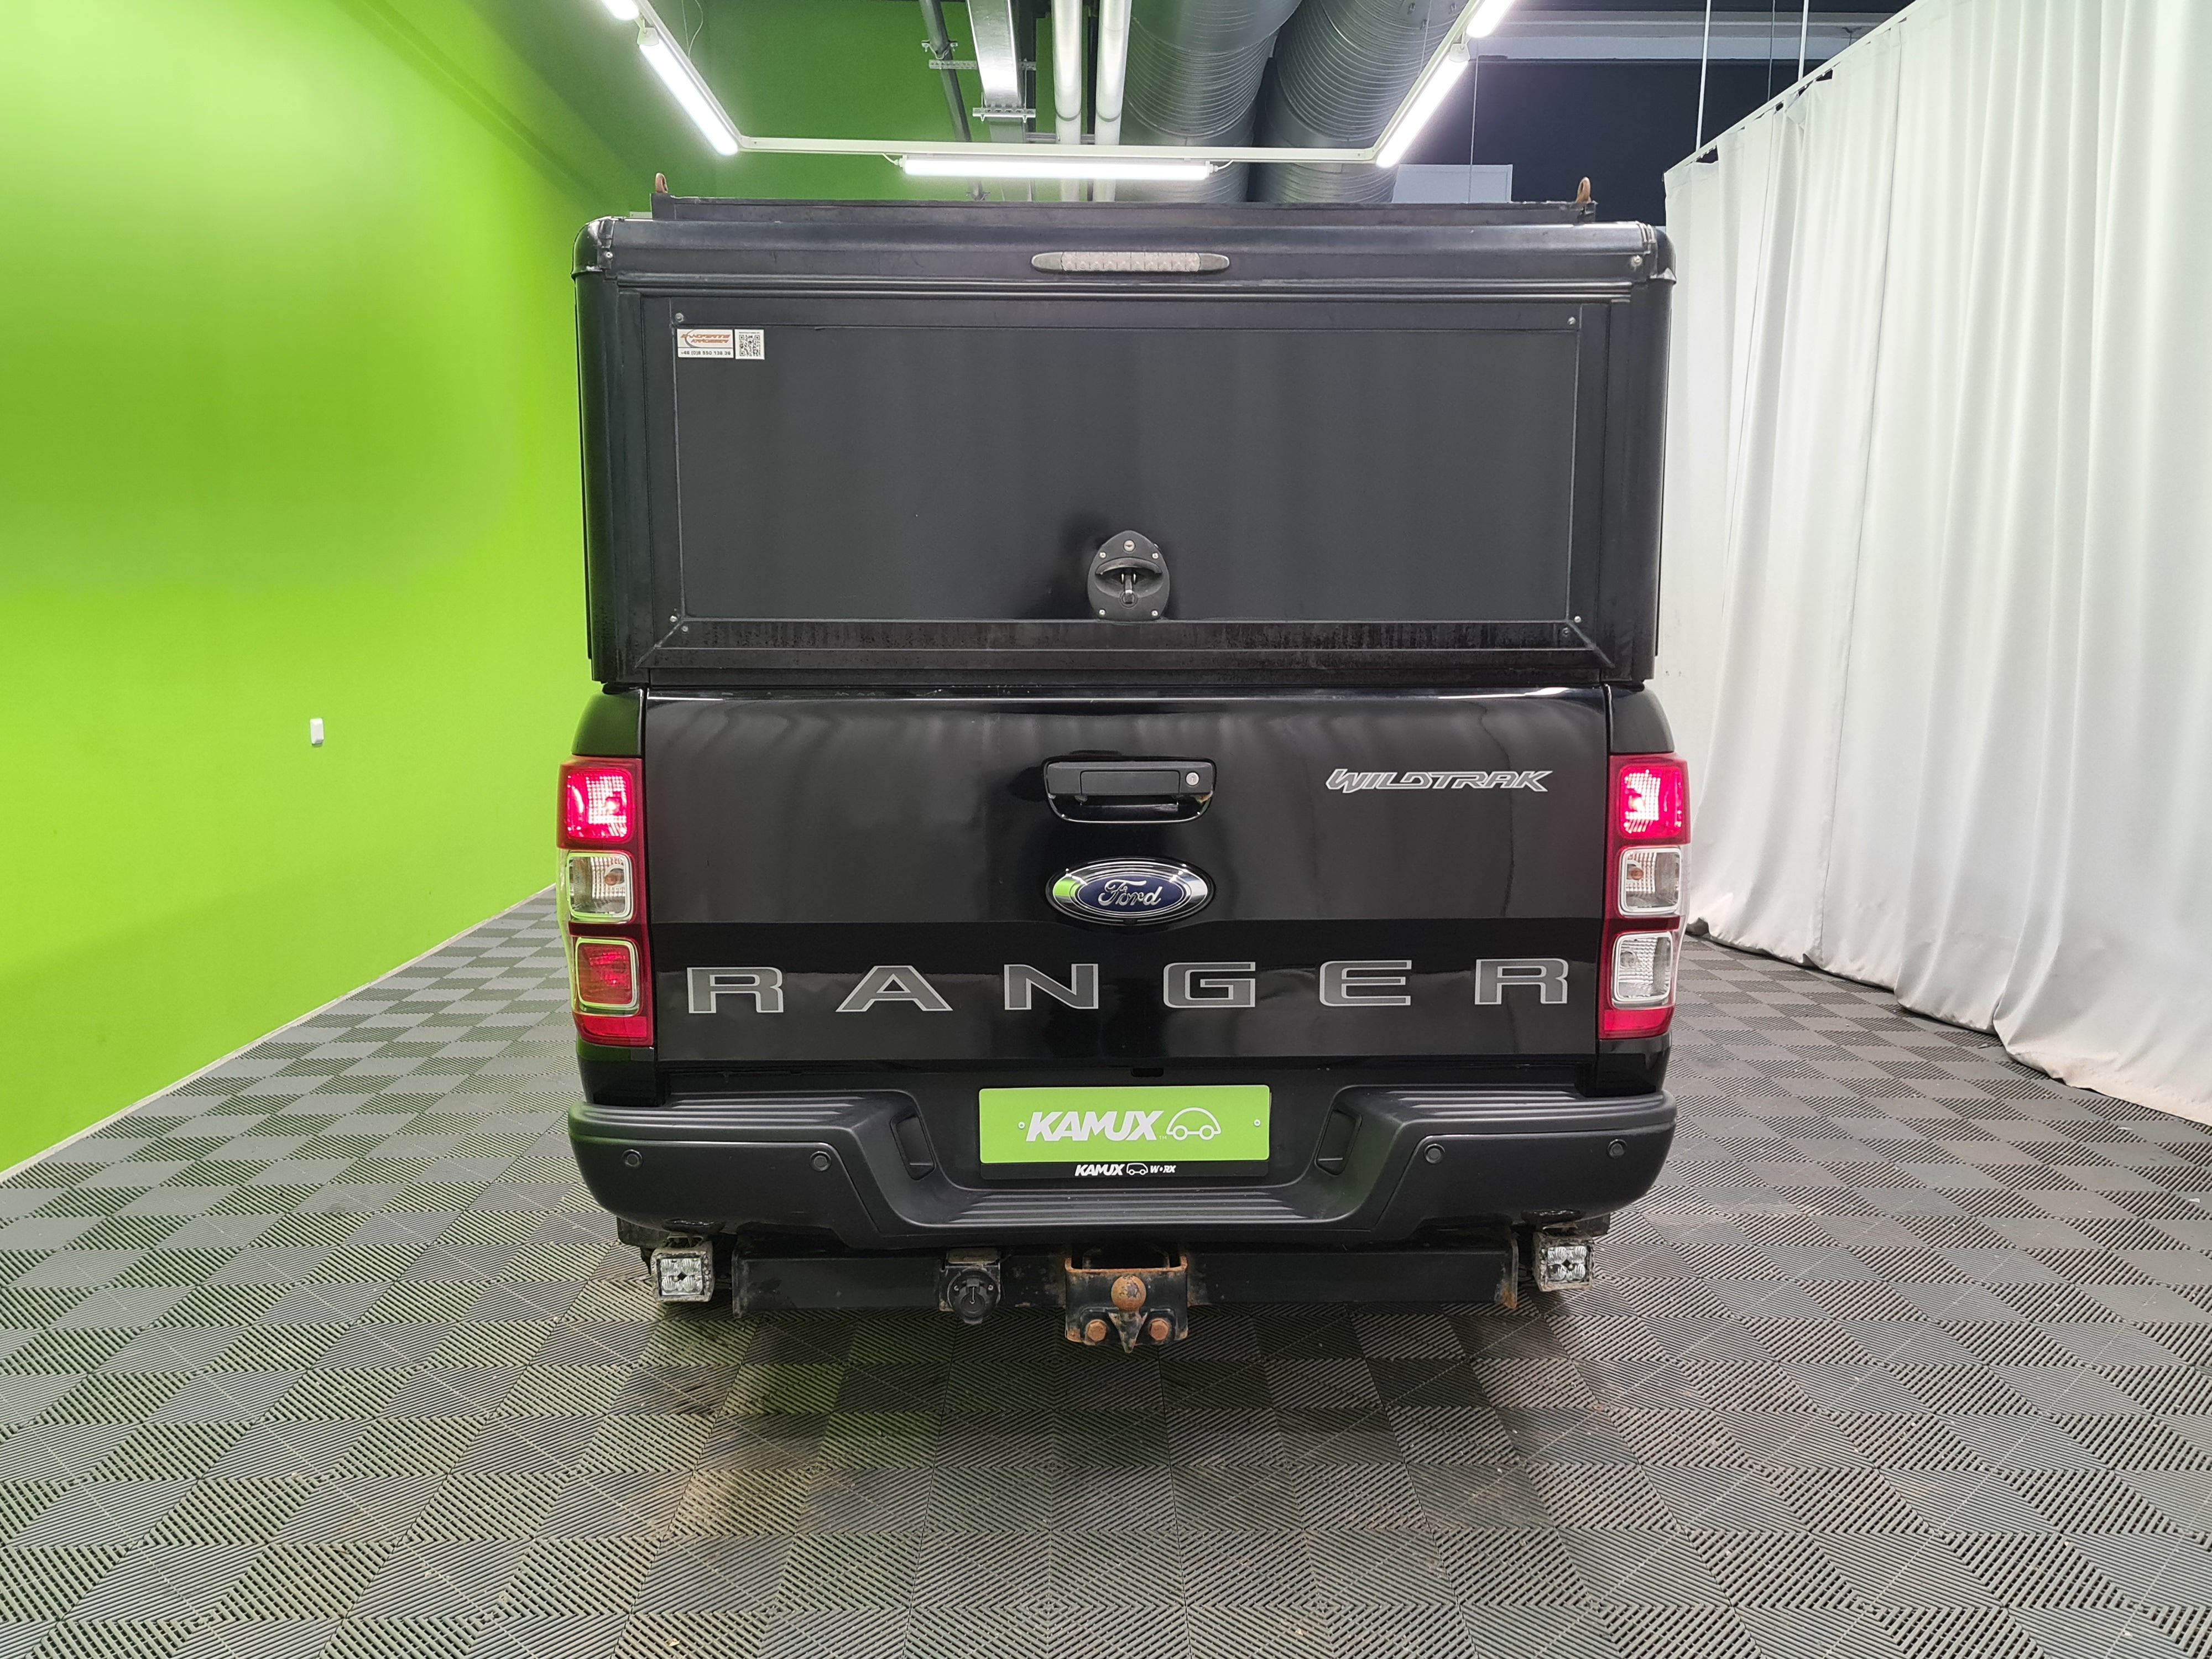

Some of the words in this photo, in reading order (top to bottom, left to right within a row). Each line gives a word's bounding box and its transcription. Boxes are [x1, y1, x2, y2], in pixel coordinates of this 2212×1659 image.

[1326, 769, 1553, 794] WILDTRAK
[1098, 879, 1163, 906] Ford
[687, 958, 1569, 1014] RANGER
[1025, 1110, 1164, 1142] KAMUX
[1074, 1164, 1125, 1176] KAMUX
